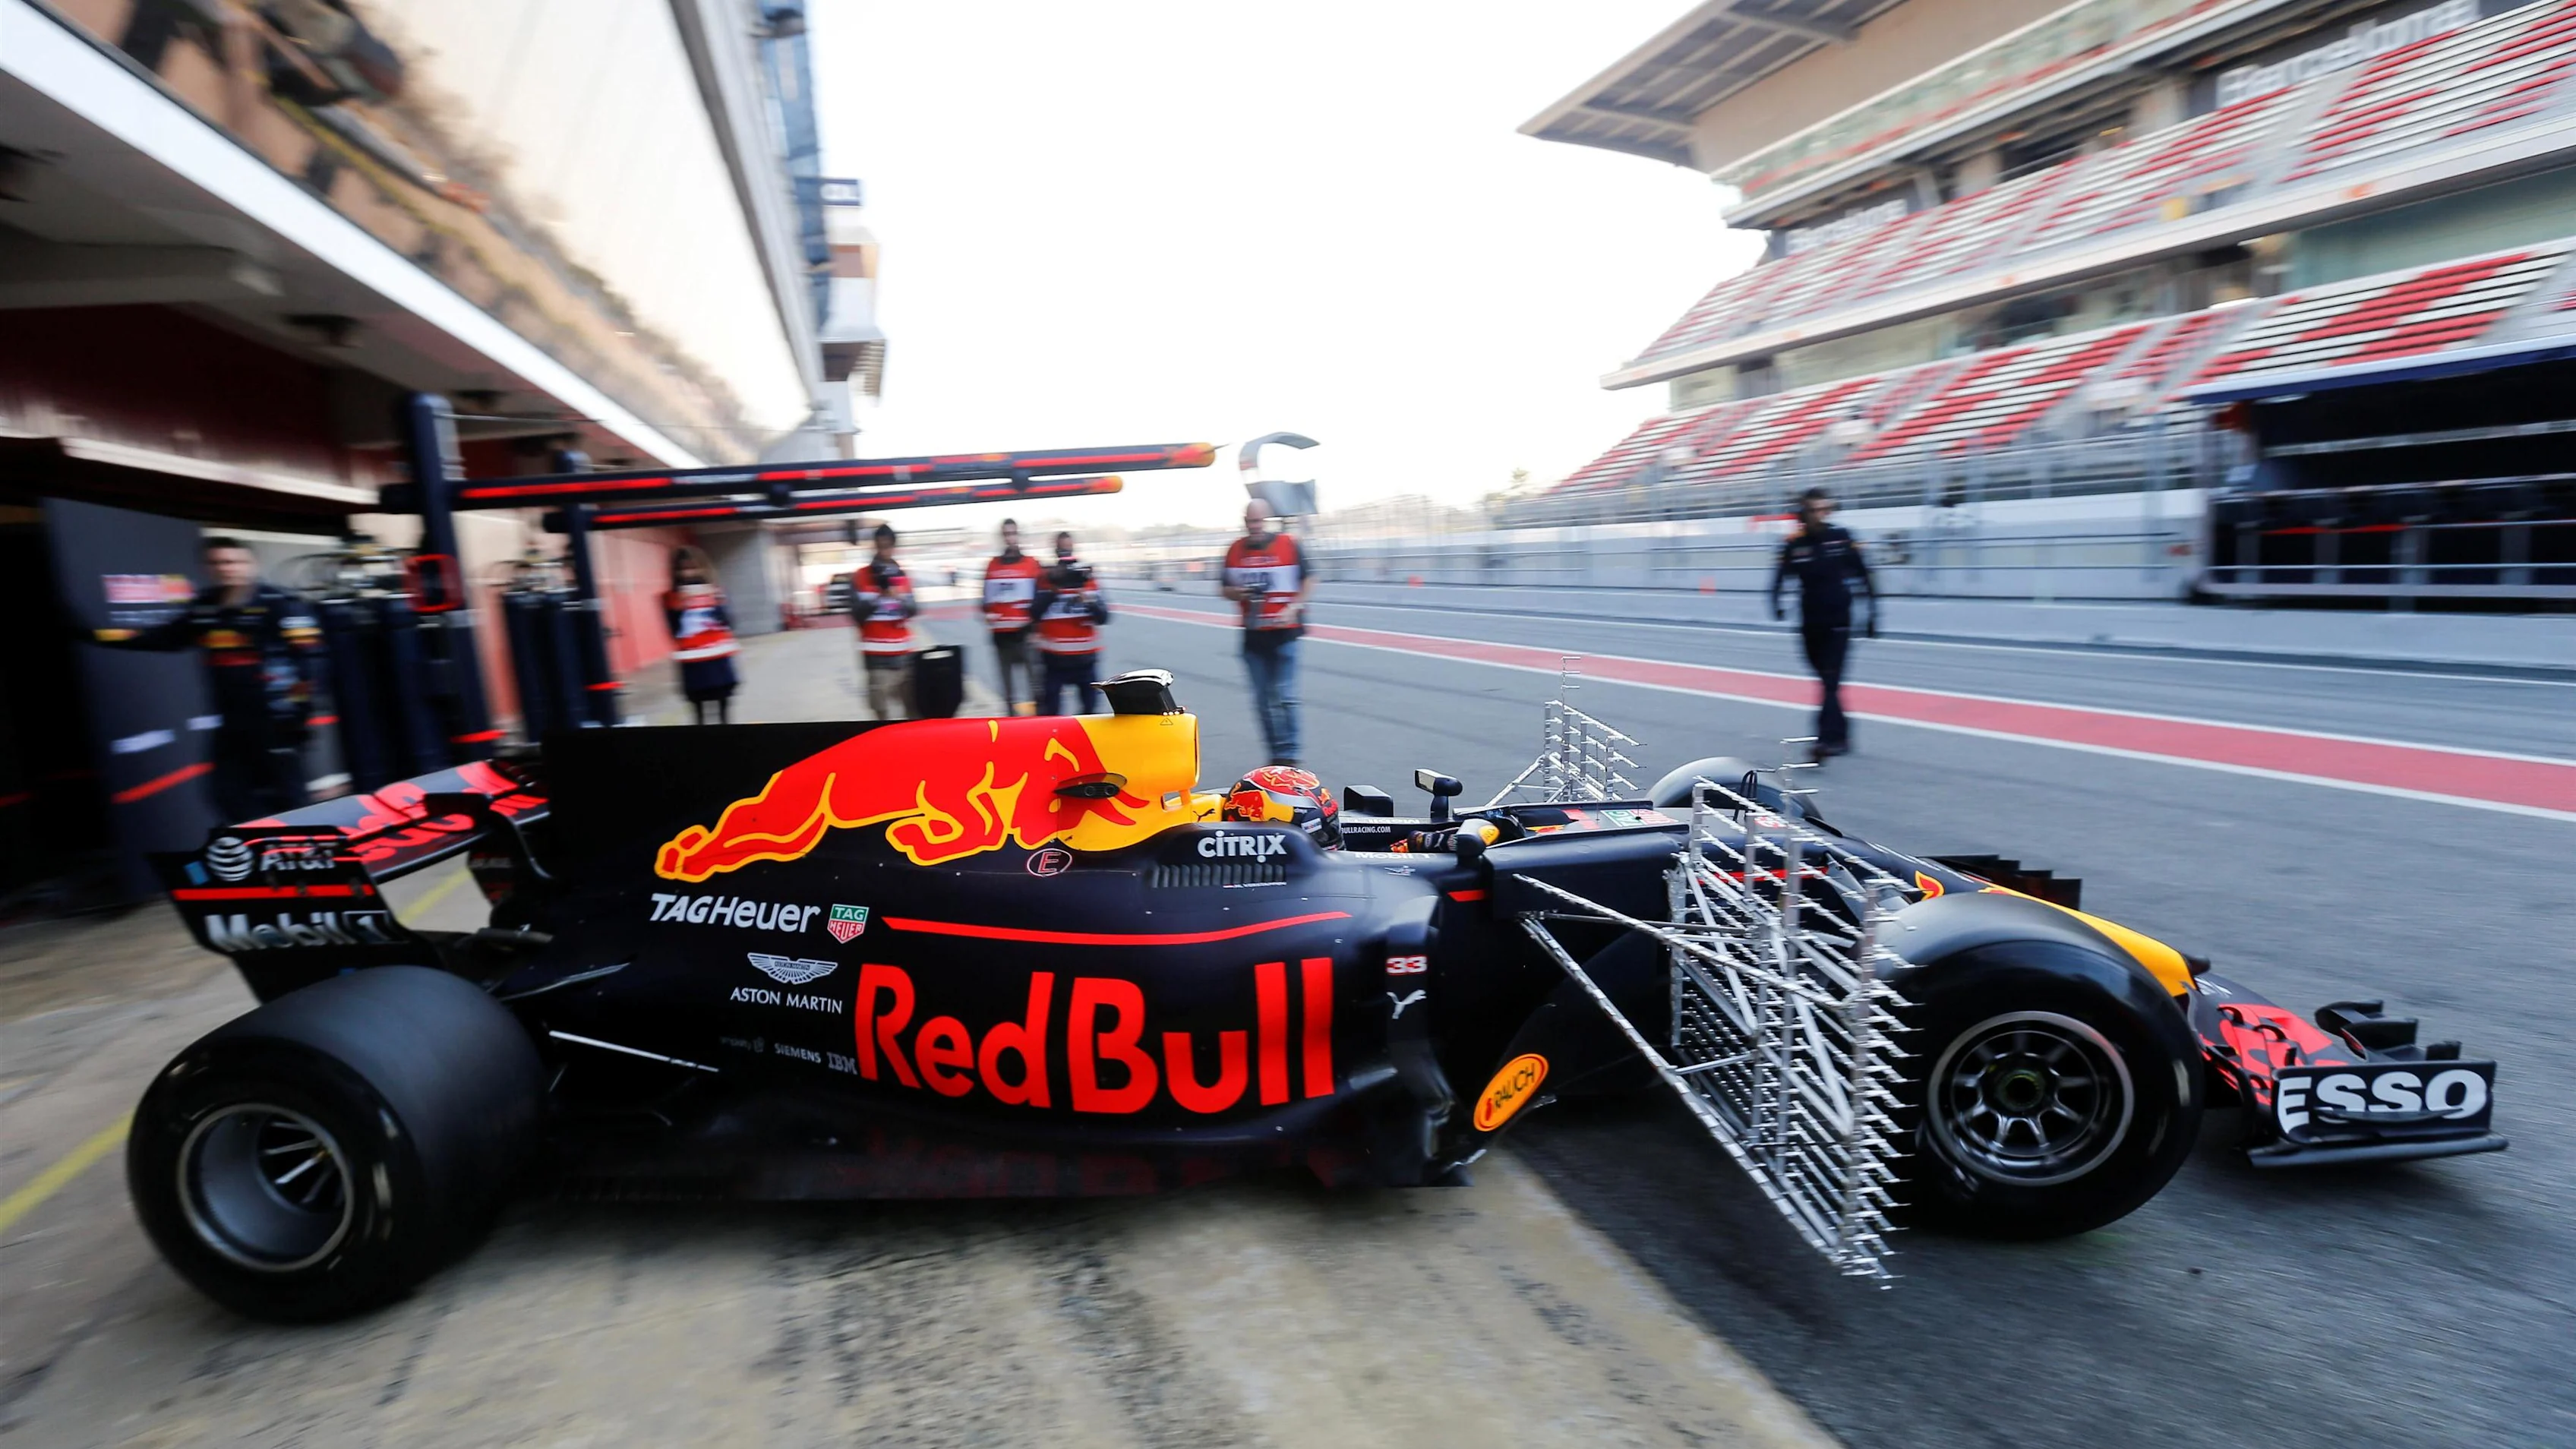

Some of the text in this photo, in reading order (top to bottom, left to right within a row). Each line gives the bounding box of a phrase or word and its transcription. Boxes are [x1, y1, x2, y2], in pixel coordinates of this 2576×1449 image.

[1038, 851, 1062, 873] E
[835, 906, 865, 920] TAG
[204, 911, 358, 952] Mobil
[829, 920, 863, 940] HEUER
[1385, 955, 1428, 975] 33
[730, 987, 843, 1015] ASTON MARTIN
[774, 1042, 822, 1064] SIEMENS
[826, 1051, 858, 1075] IBM
[1493, 1062, 1535, 1113] RAUCH
[2278, 1068, 2488, 1135] ESSO
